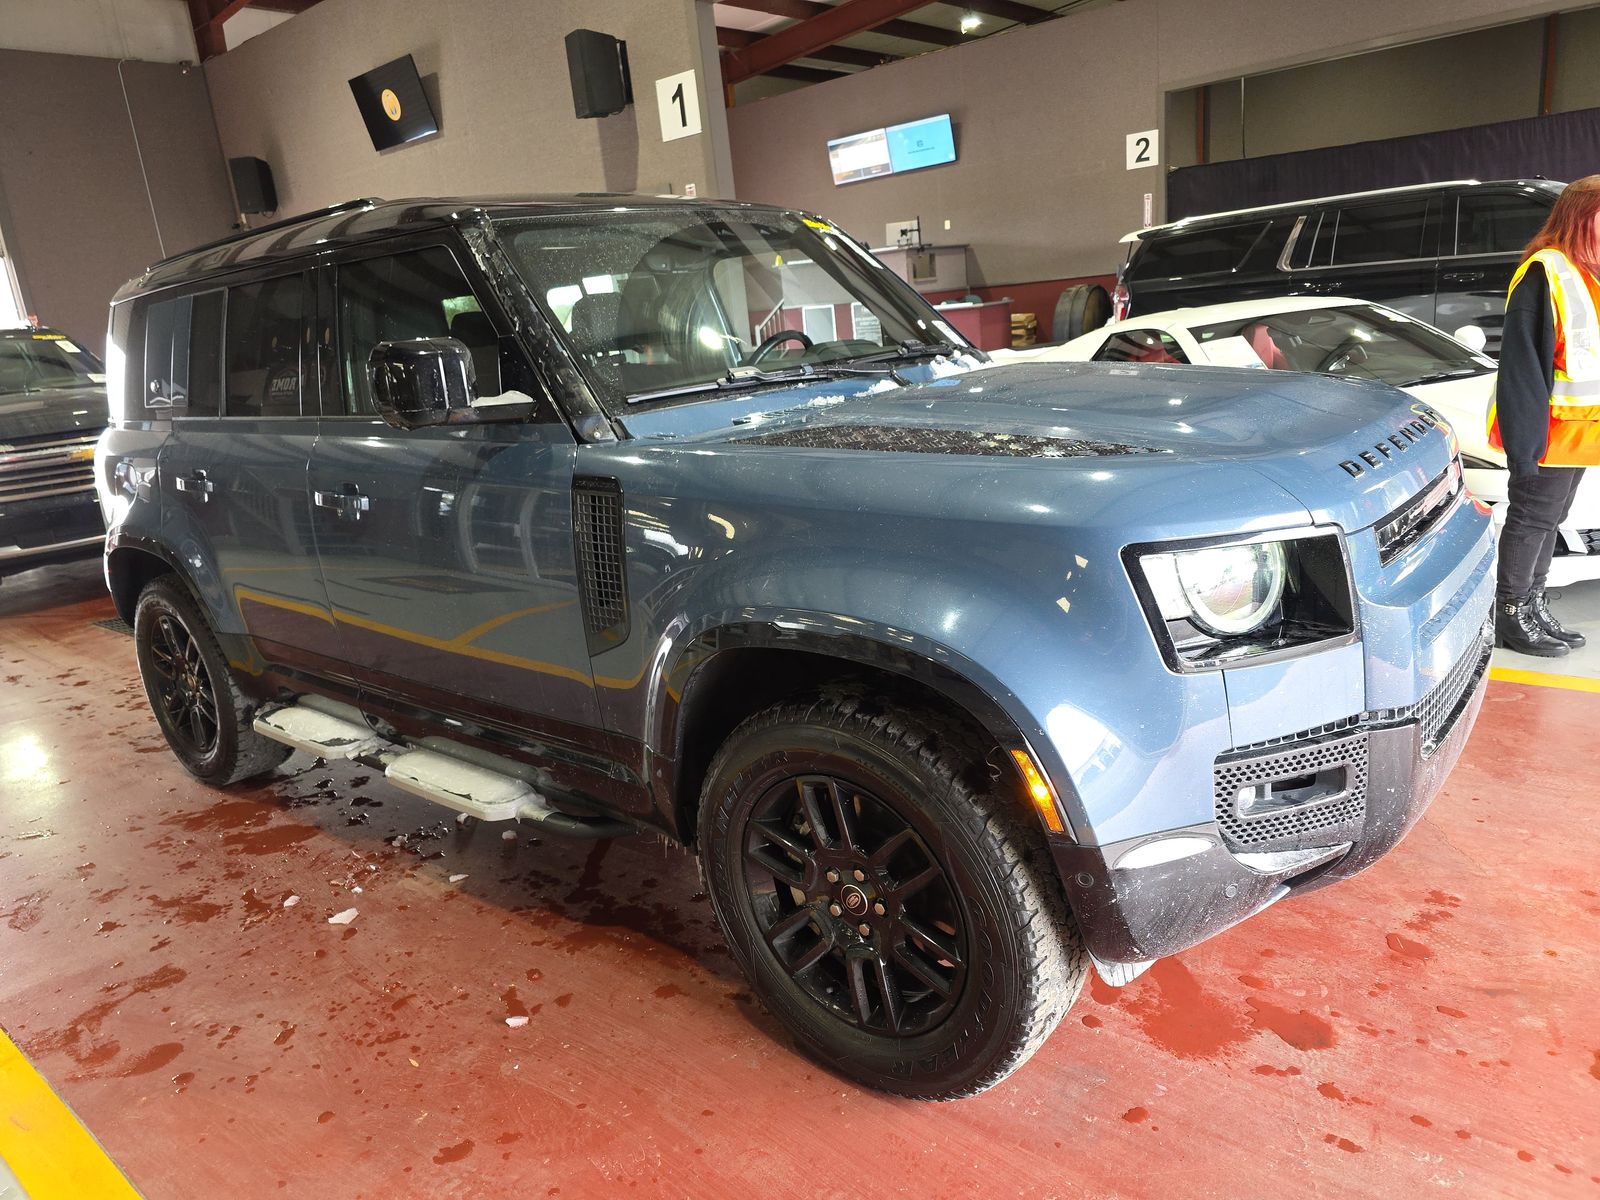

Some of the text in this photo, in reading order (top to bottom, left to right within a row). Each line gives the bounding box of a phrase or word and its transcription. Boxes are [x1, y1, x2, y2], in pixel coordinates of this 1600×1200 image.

[671, 82, 688, 128] 1
[1135, 137, 1151, 163] 2
[1338, 408, 1439, 478] DEFENDER
